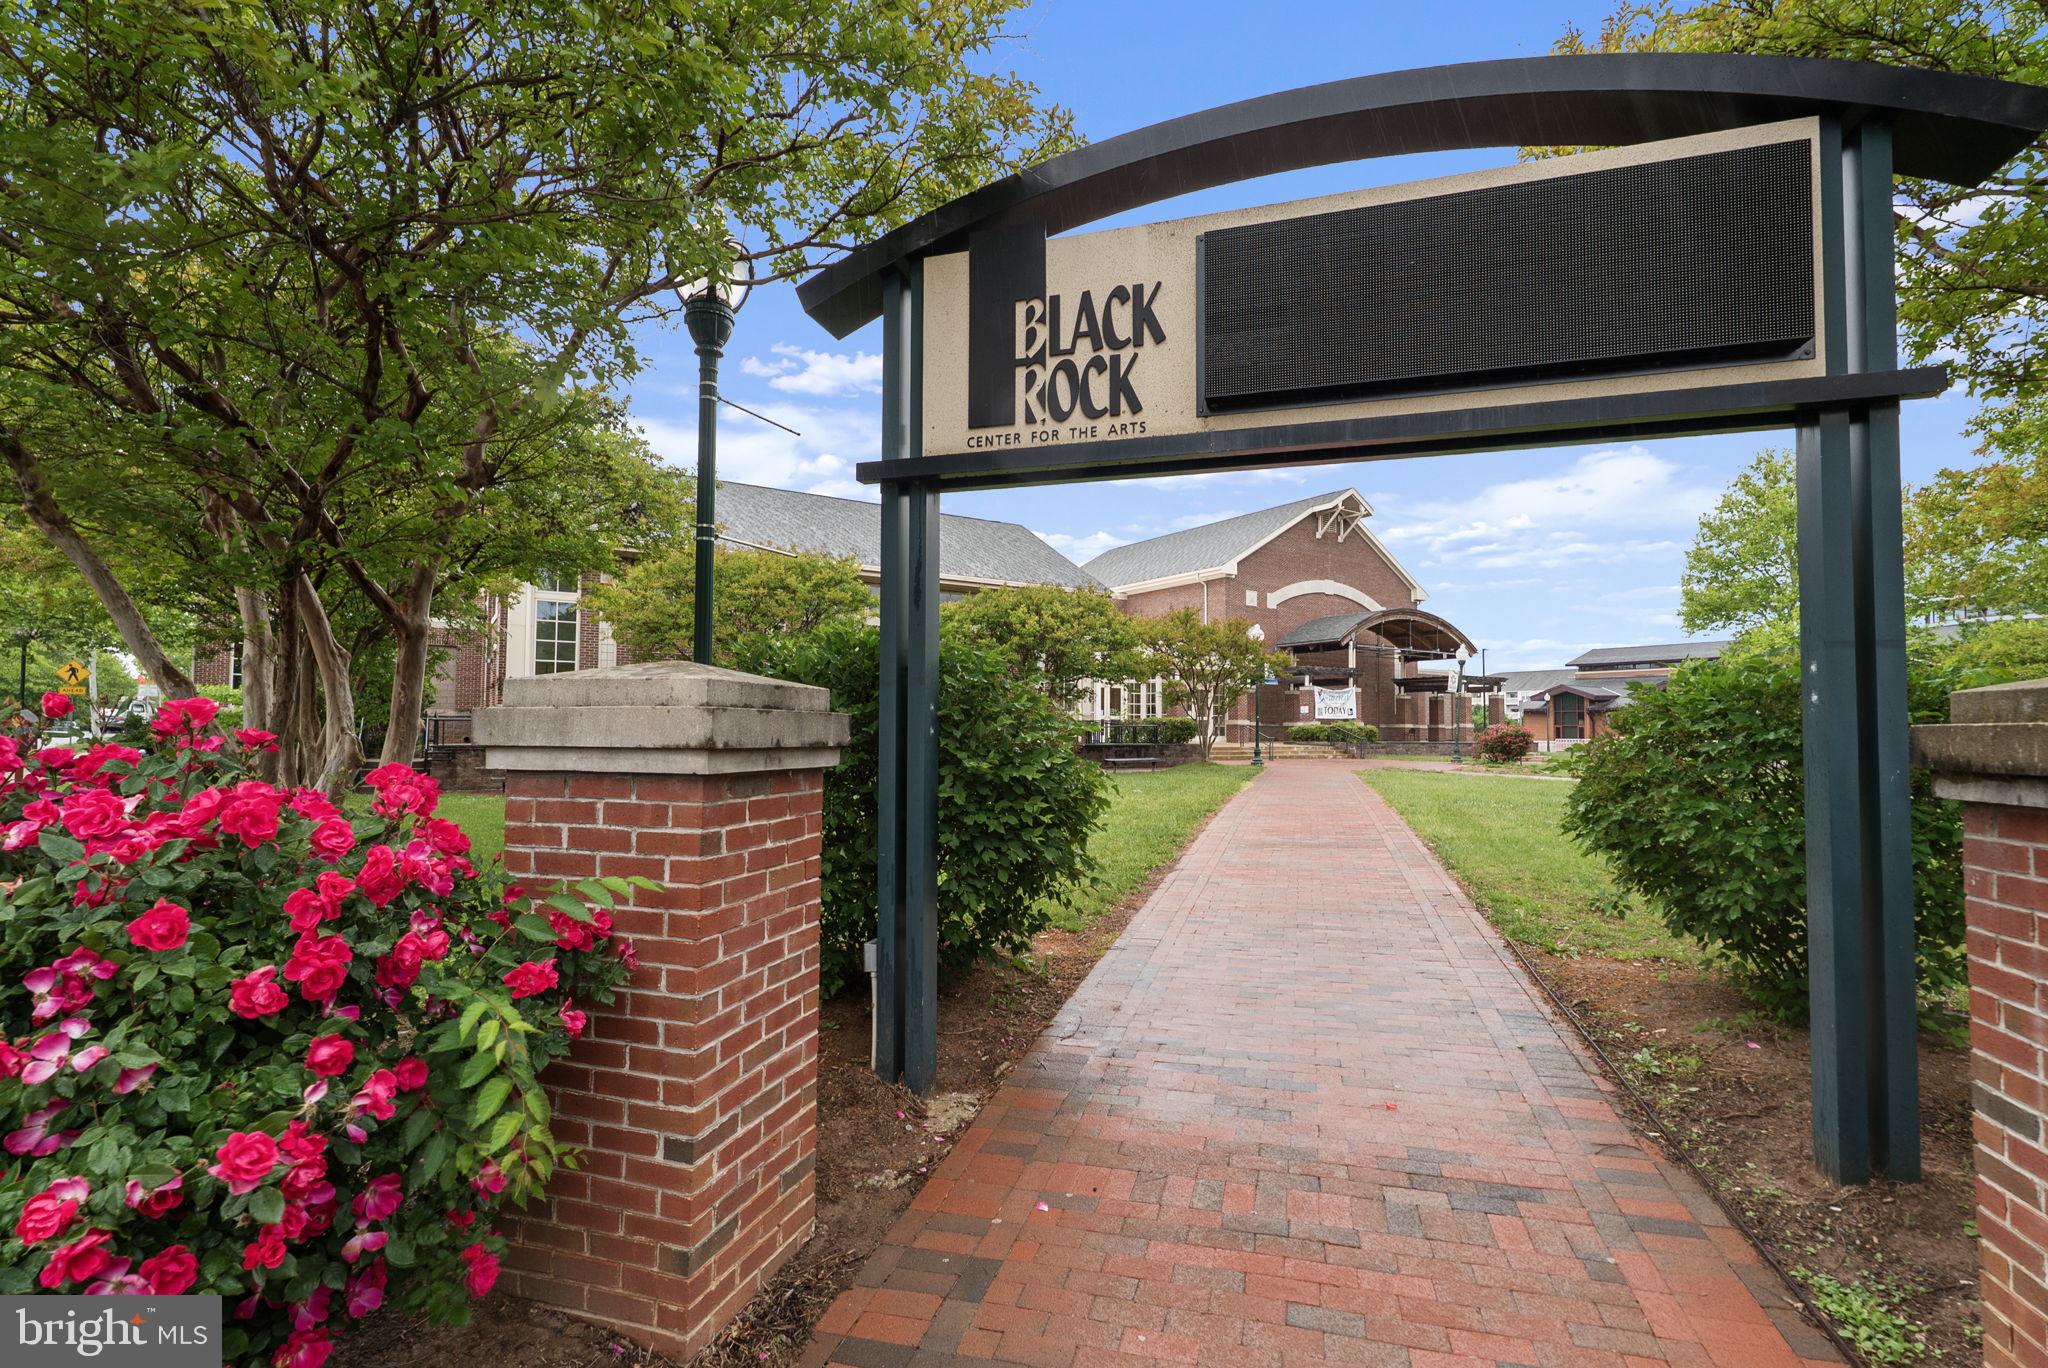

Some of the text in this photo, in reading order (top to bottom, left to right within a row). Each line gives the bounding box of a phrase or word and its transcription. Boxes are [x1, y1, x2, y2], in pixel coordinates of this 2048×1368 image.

[1014, 281, 1166, 360] BLACK
[1014, 352, 1143, 425] ROCK
[967, 421, 1147, 448] CENTER FOR THE ARTS
[1324, 706, 1347, 715] TODAY
